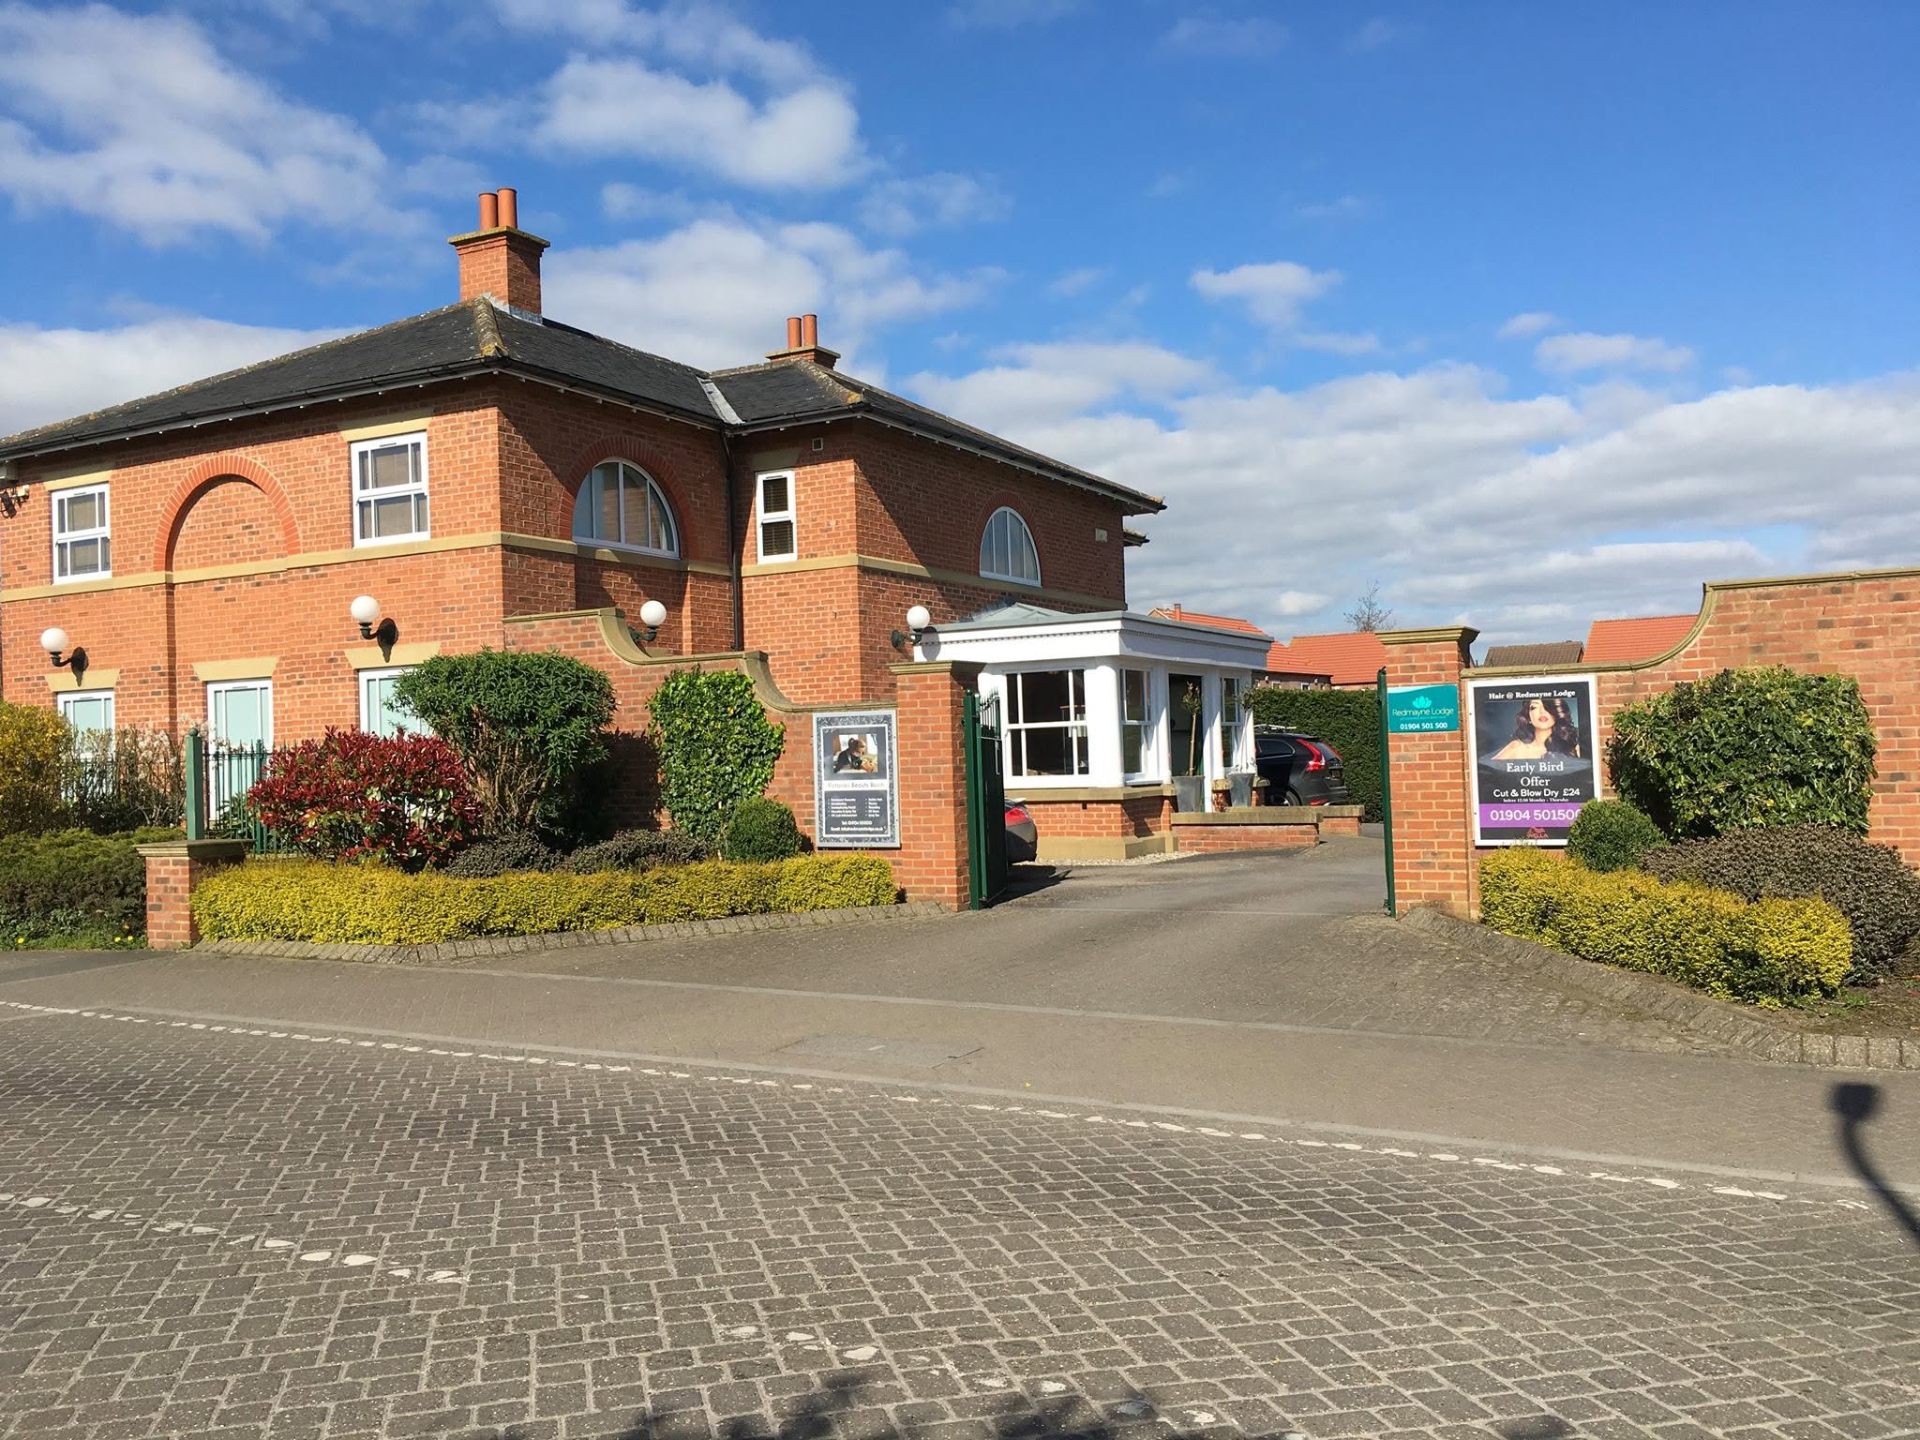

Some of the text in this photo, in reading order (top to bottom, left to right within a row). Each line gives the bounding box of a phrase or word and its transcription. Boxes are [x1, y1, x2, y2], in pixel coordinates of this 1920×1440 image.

[1515, 691, 1552, 699] Redmayne
[1553, 689, 1576, 698] Lodge
[1392, 707, 1454, 718] Redmayne Lodge
[1506, 761, 1564, 775] Early Bird
[1520, 776, 1551, 787] Offer
[1493, 788, 1580, 798] Cut & Blow Dry £24
[1490, 810, 1530, 821] 01904
